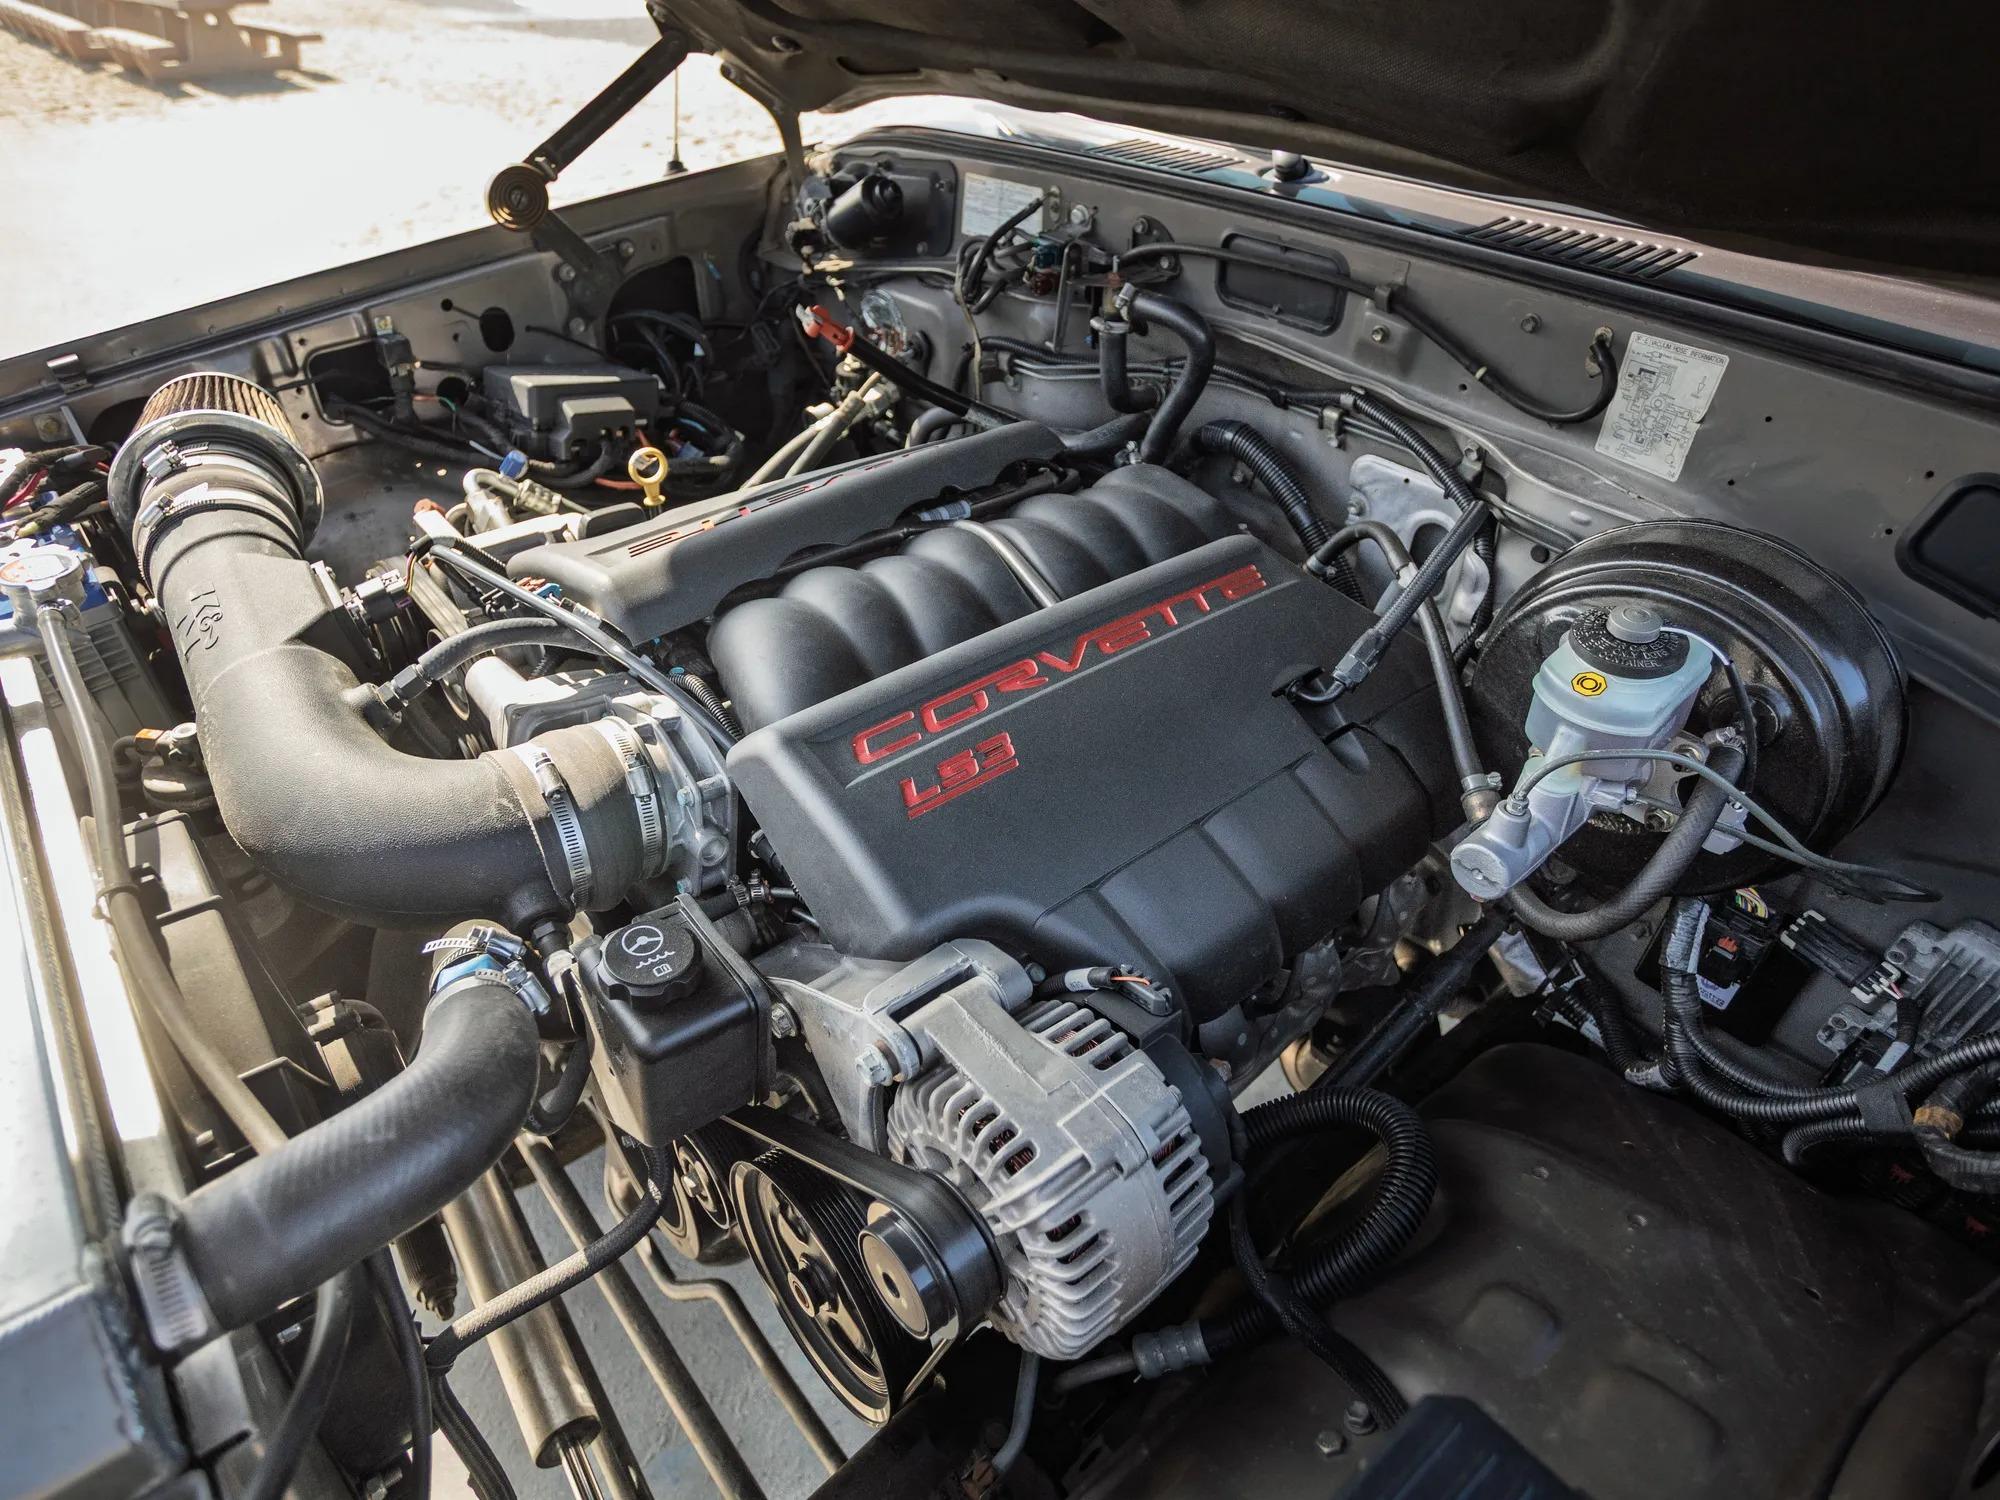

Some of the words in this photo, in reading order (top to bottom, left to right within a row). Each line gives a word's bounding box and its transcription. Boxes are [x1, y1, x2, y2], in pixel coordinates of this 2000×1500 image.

[1650, 339, 1672, 351] VACUUM
[1673, 344, 1689, 355] HOSE
[1690, 350, 1725, 365] INFORMATION
[853, 563, 1267, 765] CORVETTE
[900, 731, 1017, 807] LS3
